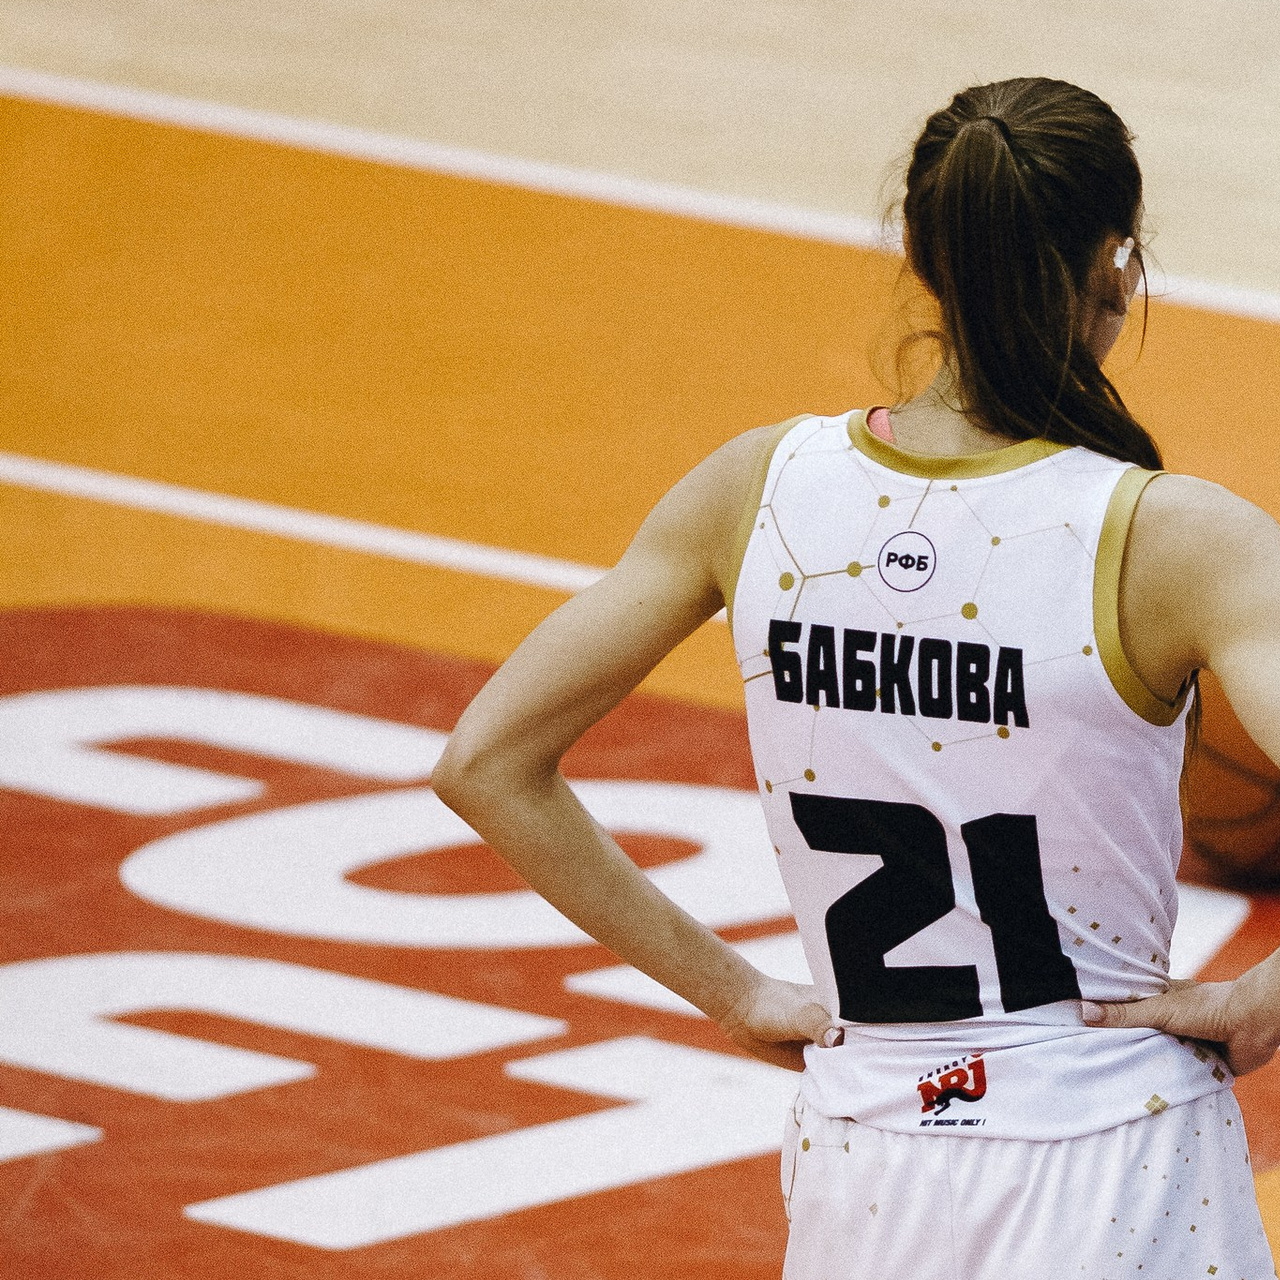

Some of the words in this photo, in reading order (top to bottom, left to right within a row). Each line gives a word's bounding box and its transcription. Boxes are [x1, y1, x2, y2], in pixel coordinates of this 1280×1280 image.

[885, 551, 930, 572] РФБ
[768, 618, 1030, 729] БАБКОВА
[788, 791, 1083, 1024] 21
[916, 1057, 988, 1114] NRJ
